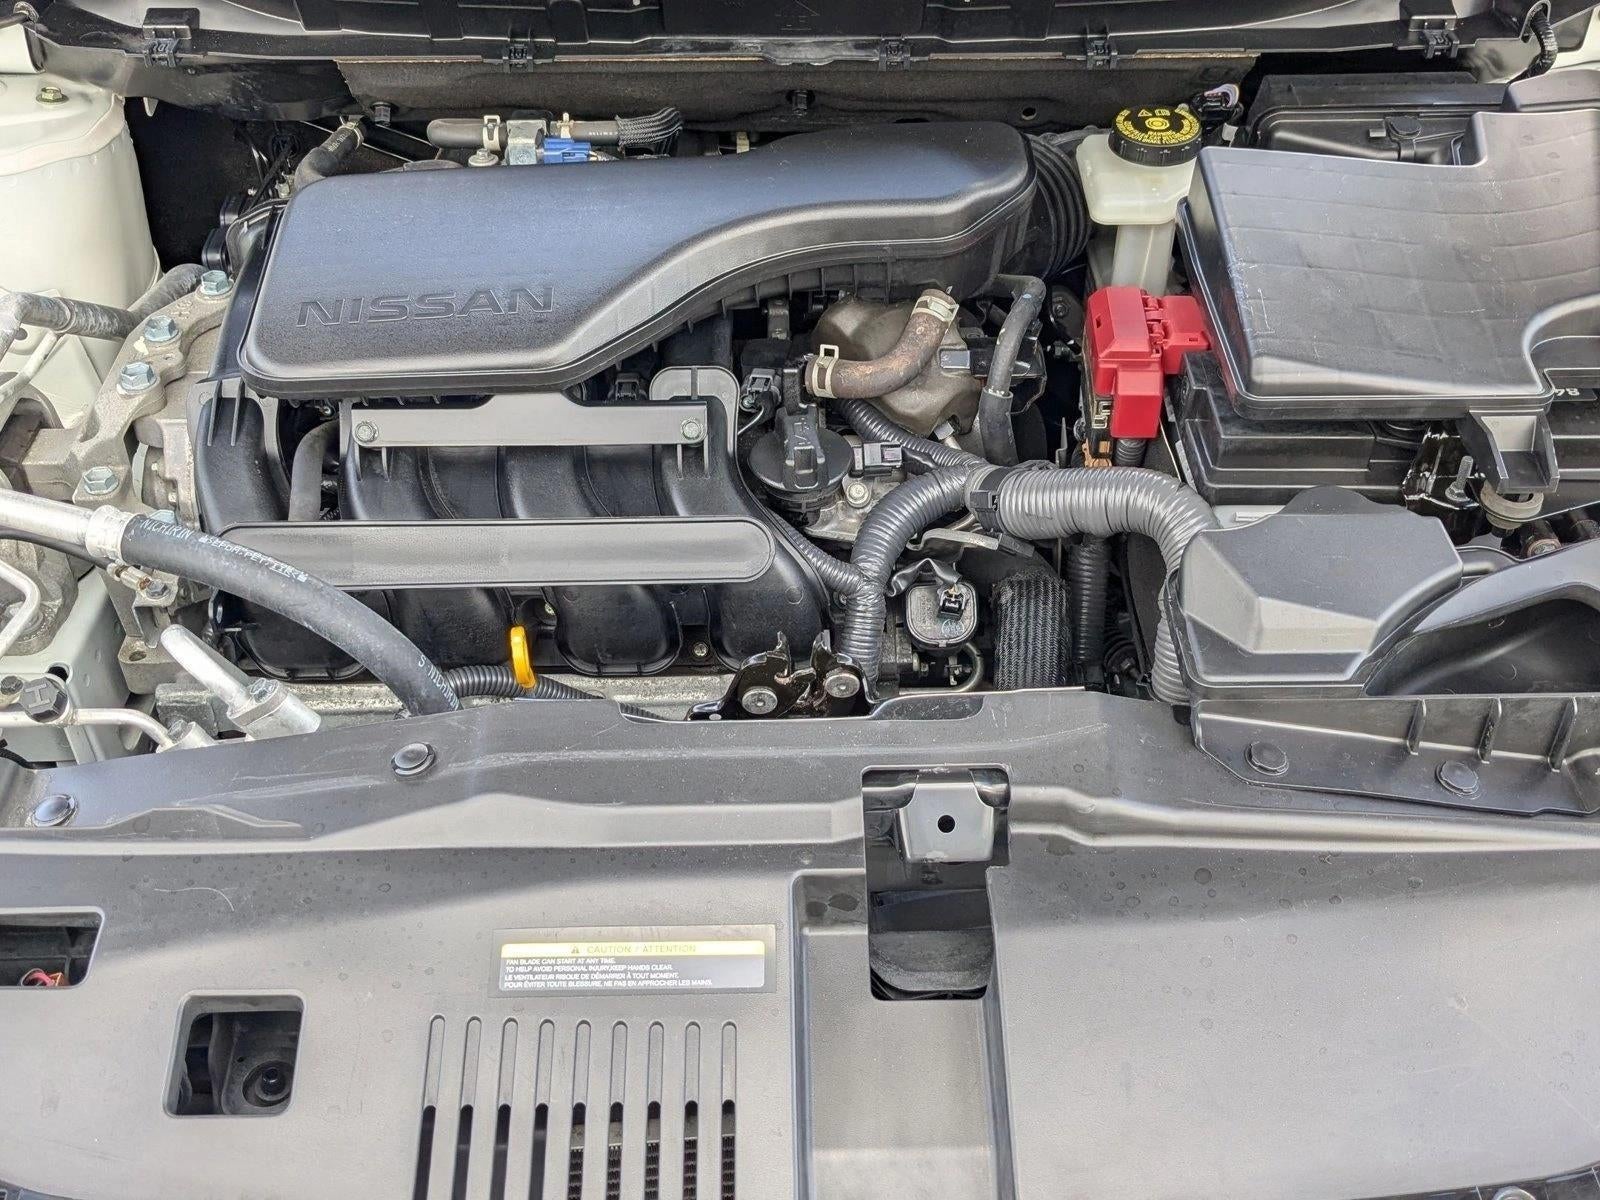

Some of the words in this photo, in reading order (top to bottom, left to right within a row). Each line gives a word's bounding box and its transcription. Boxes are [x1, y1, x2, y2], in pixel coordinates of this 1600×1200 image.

[296, 287, 554, 327] NISSAN
[140, 519, 195, 540] NICHIRIN
[587, 945, 632, 954] CAUTION
[643, 944, 696, 953] ATTENTION
[523, 980, 546, 988] ÉVITER
